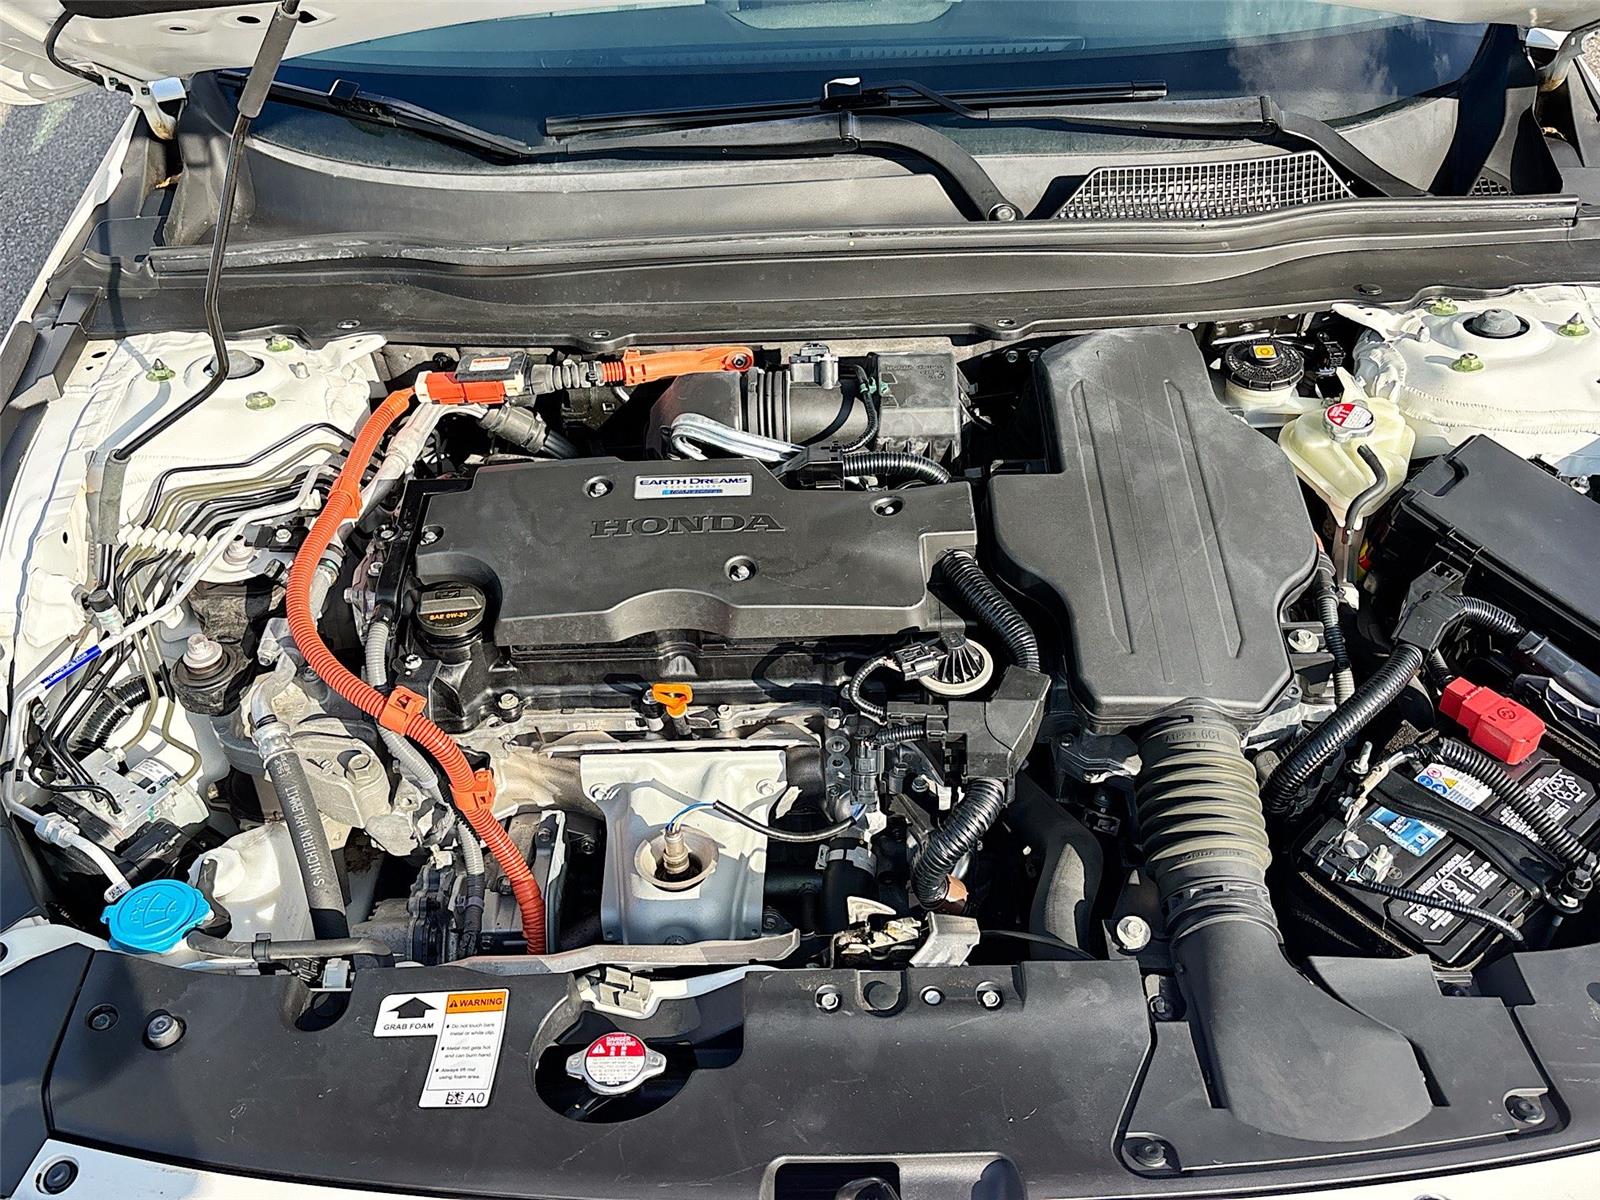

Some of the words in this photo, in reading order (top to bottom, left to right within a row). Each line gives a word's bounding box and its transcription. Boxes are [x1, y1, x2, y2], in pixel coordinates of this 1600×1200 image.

[689, 477, 748, 485] DREAMS
[590, 513, 786, 538] HONDA
[1438, 853, 1464, 876] POISON
[459, 998, 503, 1007] WARNING
[409, 1022, 434, 1030] FOAM
[465, 1092, 485, 1104] A0
